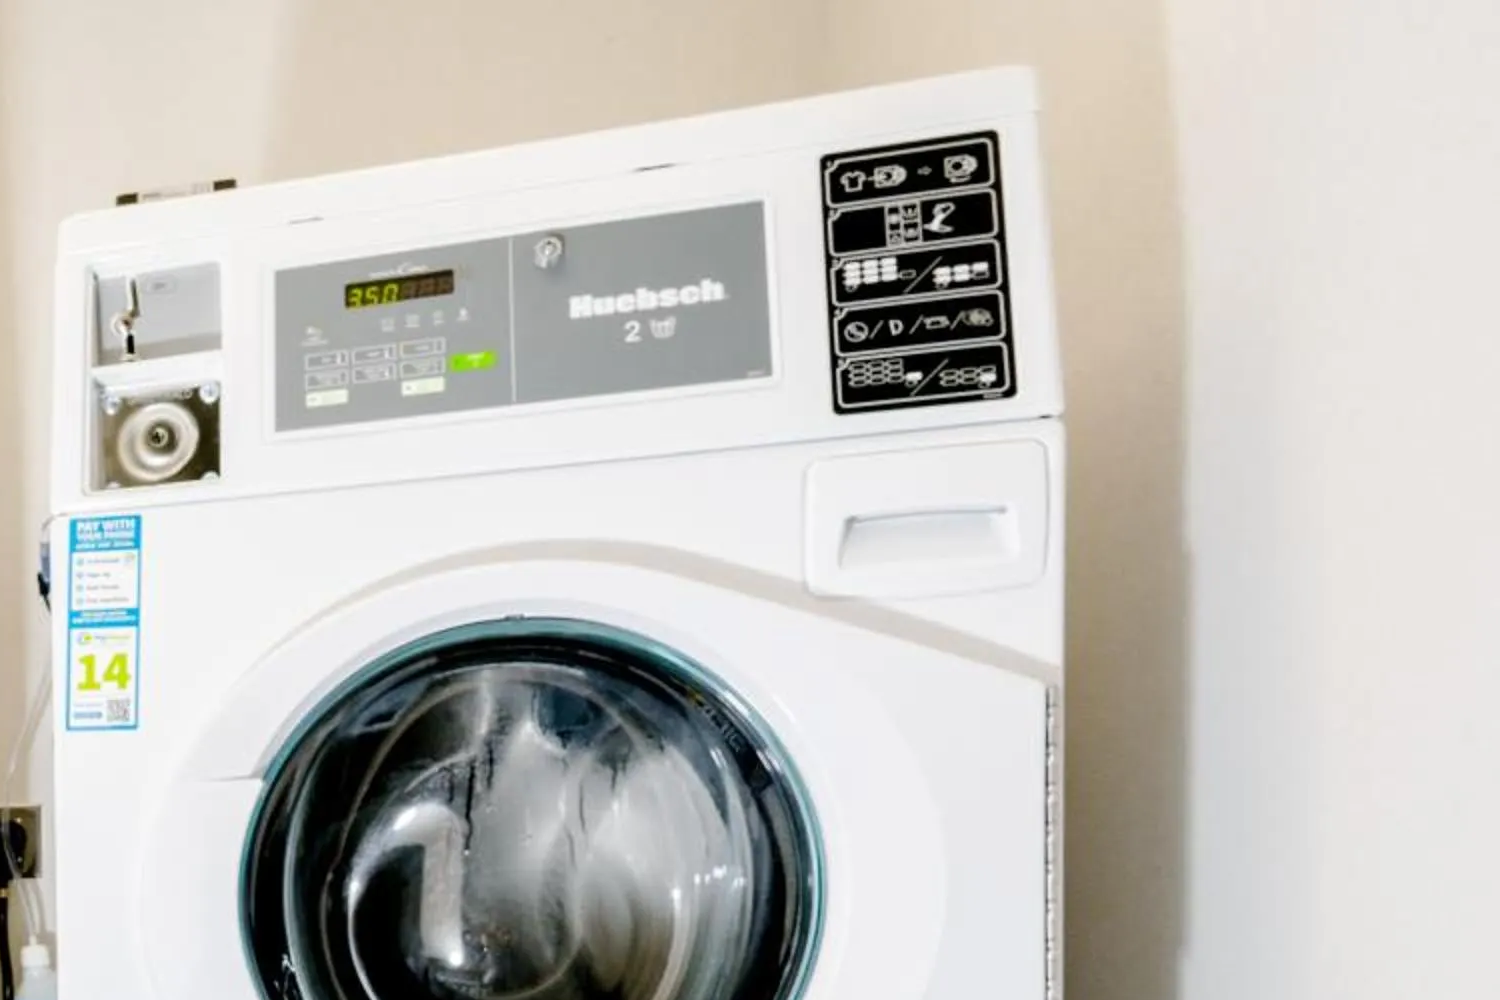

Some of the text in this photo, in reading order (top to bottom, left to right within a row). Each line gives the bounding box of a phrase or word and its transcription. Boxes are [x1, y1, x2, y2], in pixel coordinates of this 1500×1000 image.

[568, 277, 726, 320] Huebsch
[623, 320, 642, 343] 2
[77, 653, 131, 691] 14
